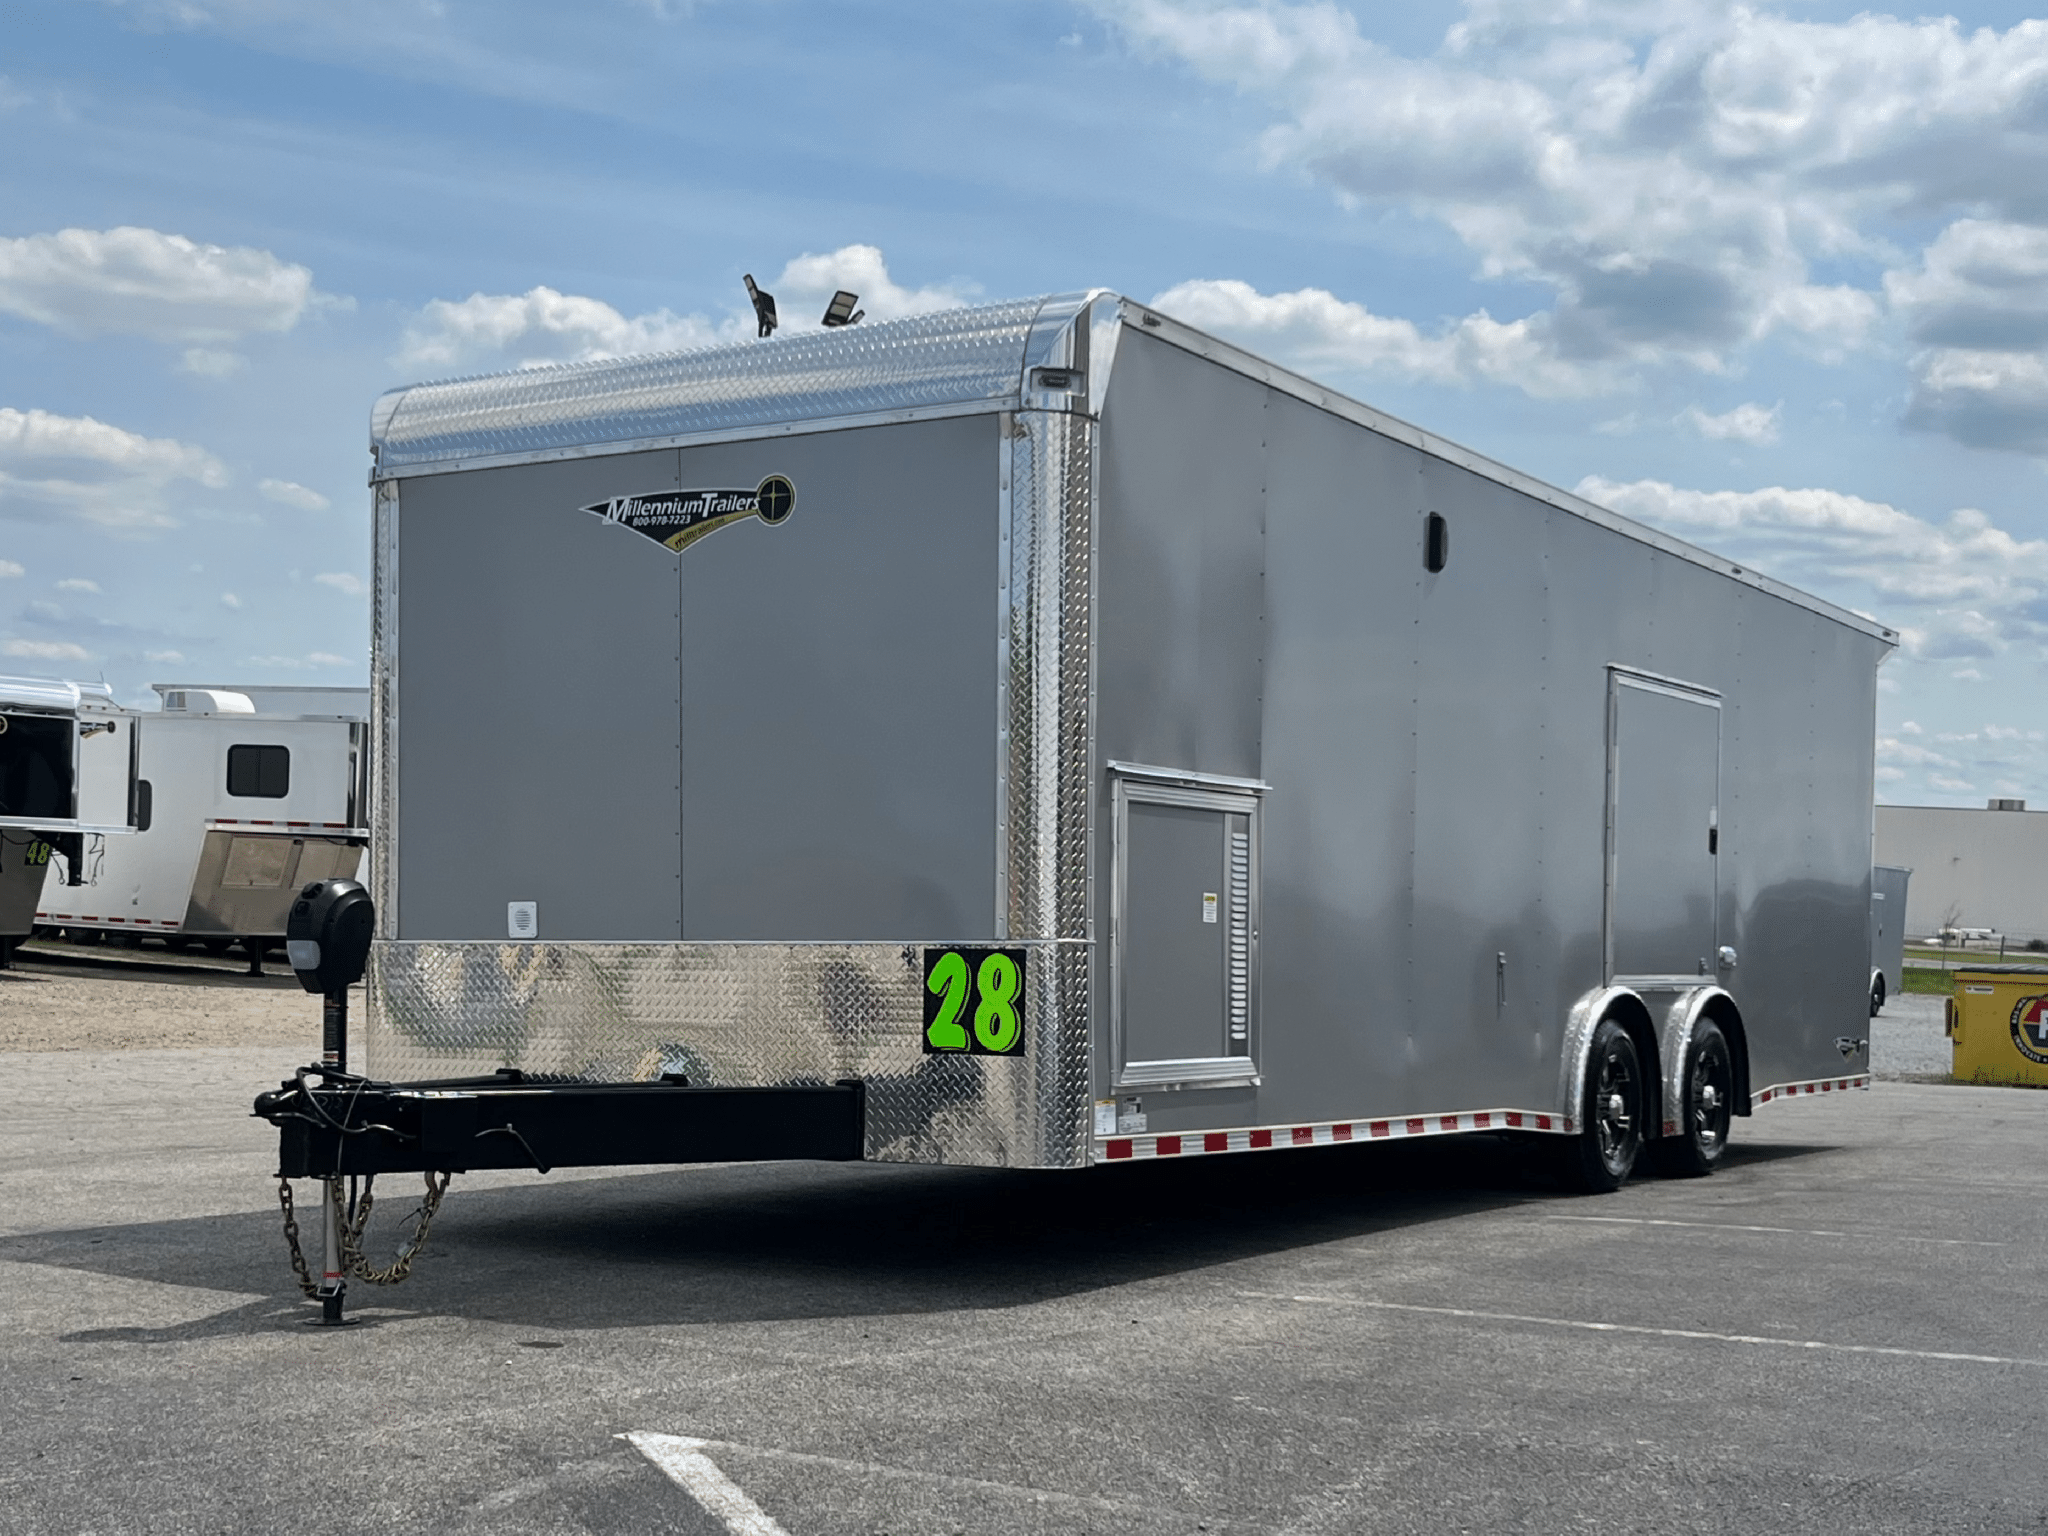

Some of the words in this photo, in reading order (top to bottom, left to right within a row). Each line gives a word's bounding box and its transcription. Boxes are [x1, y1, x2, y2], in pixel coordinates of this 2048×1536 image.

[632, 514, 691, 527] 800-978-7223
[27, 842, 50, 864] 48
[926, 951, 1022, 1052] 28
